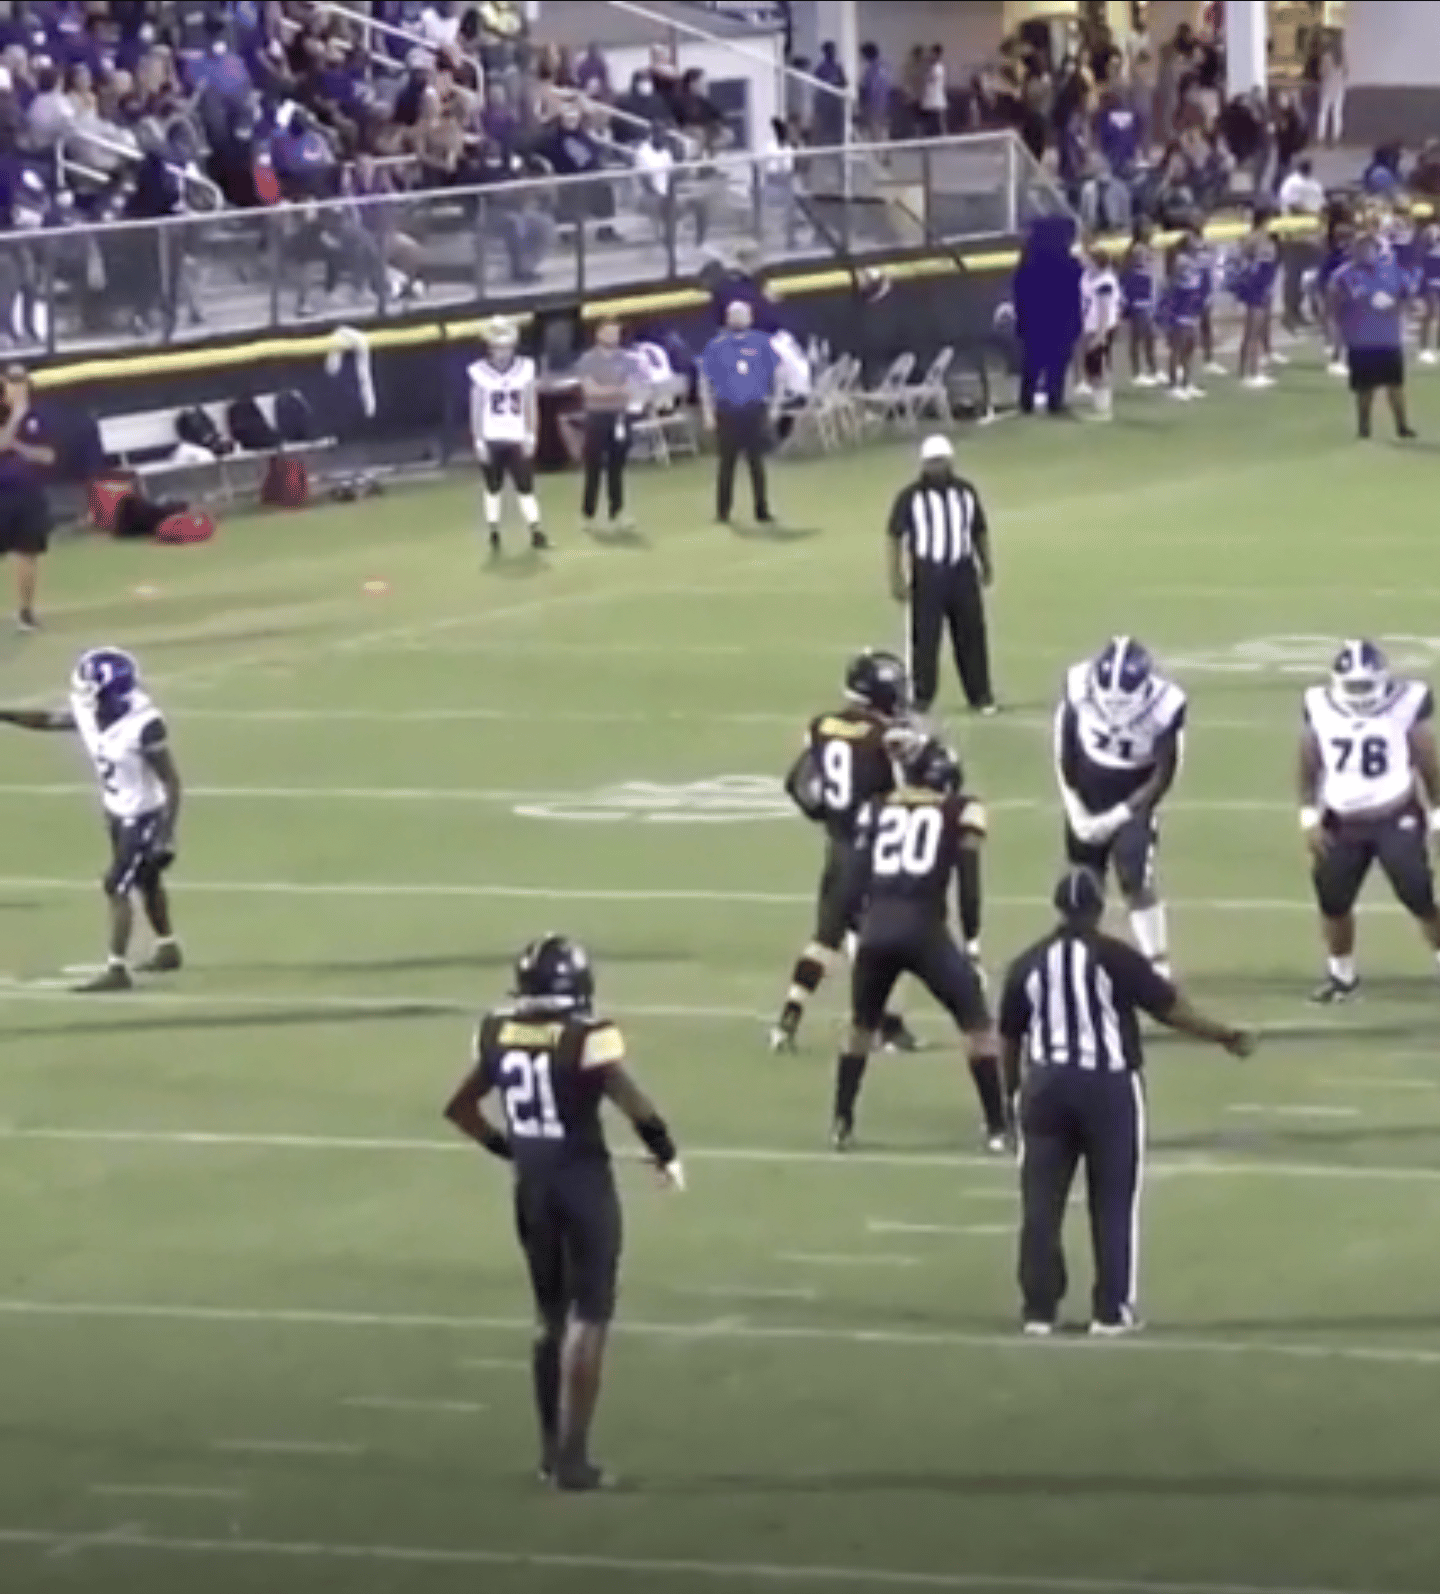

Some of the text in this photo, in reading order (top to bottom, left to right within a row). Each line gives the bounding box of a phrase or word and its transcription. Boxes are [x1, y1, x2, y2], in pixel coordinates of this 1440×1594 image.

[823, 739, 852, 809] 9
[1330, 736, 1388, 778] 76
[873, 806, 943, 874] 20
[501, 1049, 565, 1138] 21
